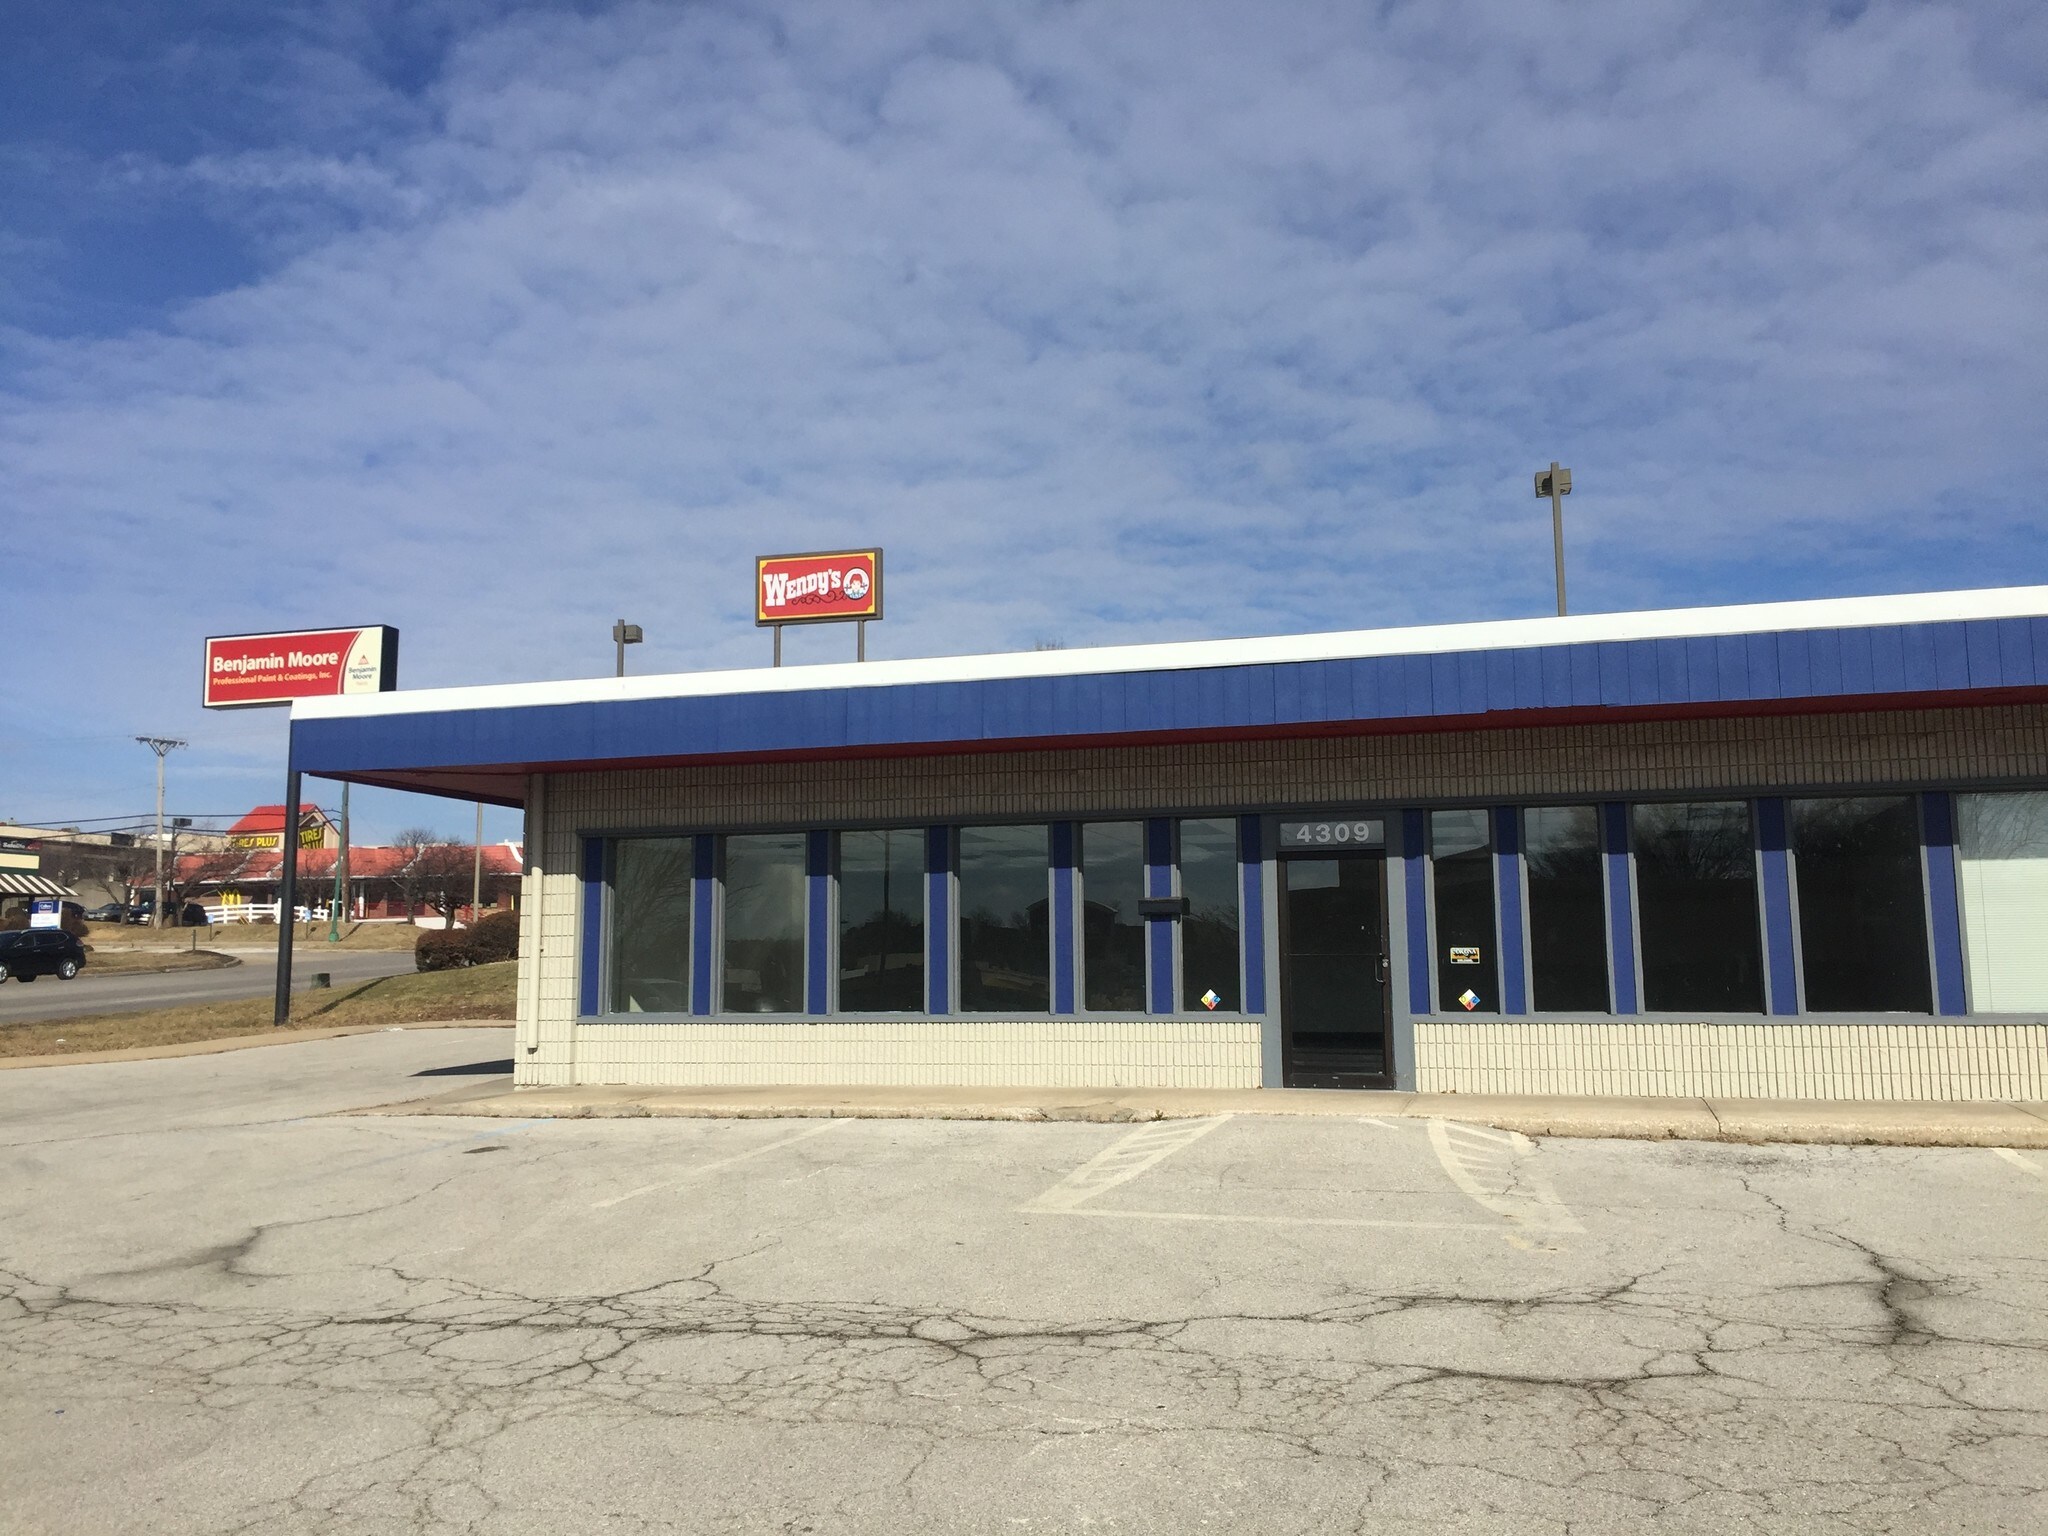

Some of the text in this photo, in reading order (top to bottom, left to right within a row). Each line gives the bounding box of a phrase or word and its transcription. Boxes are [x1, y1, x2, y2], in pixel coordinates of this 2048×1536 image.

[213, 651, 339, 675] Benjamin Moore
[213, 671, 333, 686] Professional Paint & Coatings, Inc.
[299, 827, 323, 844] TIRES
[1296, 822, 1369, 843] 4309
[257, 836, 278, 847] PLUS
